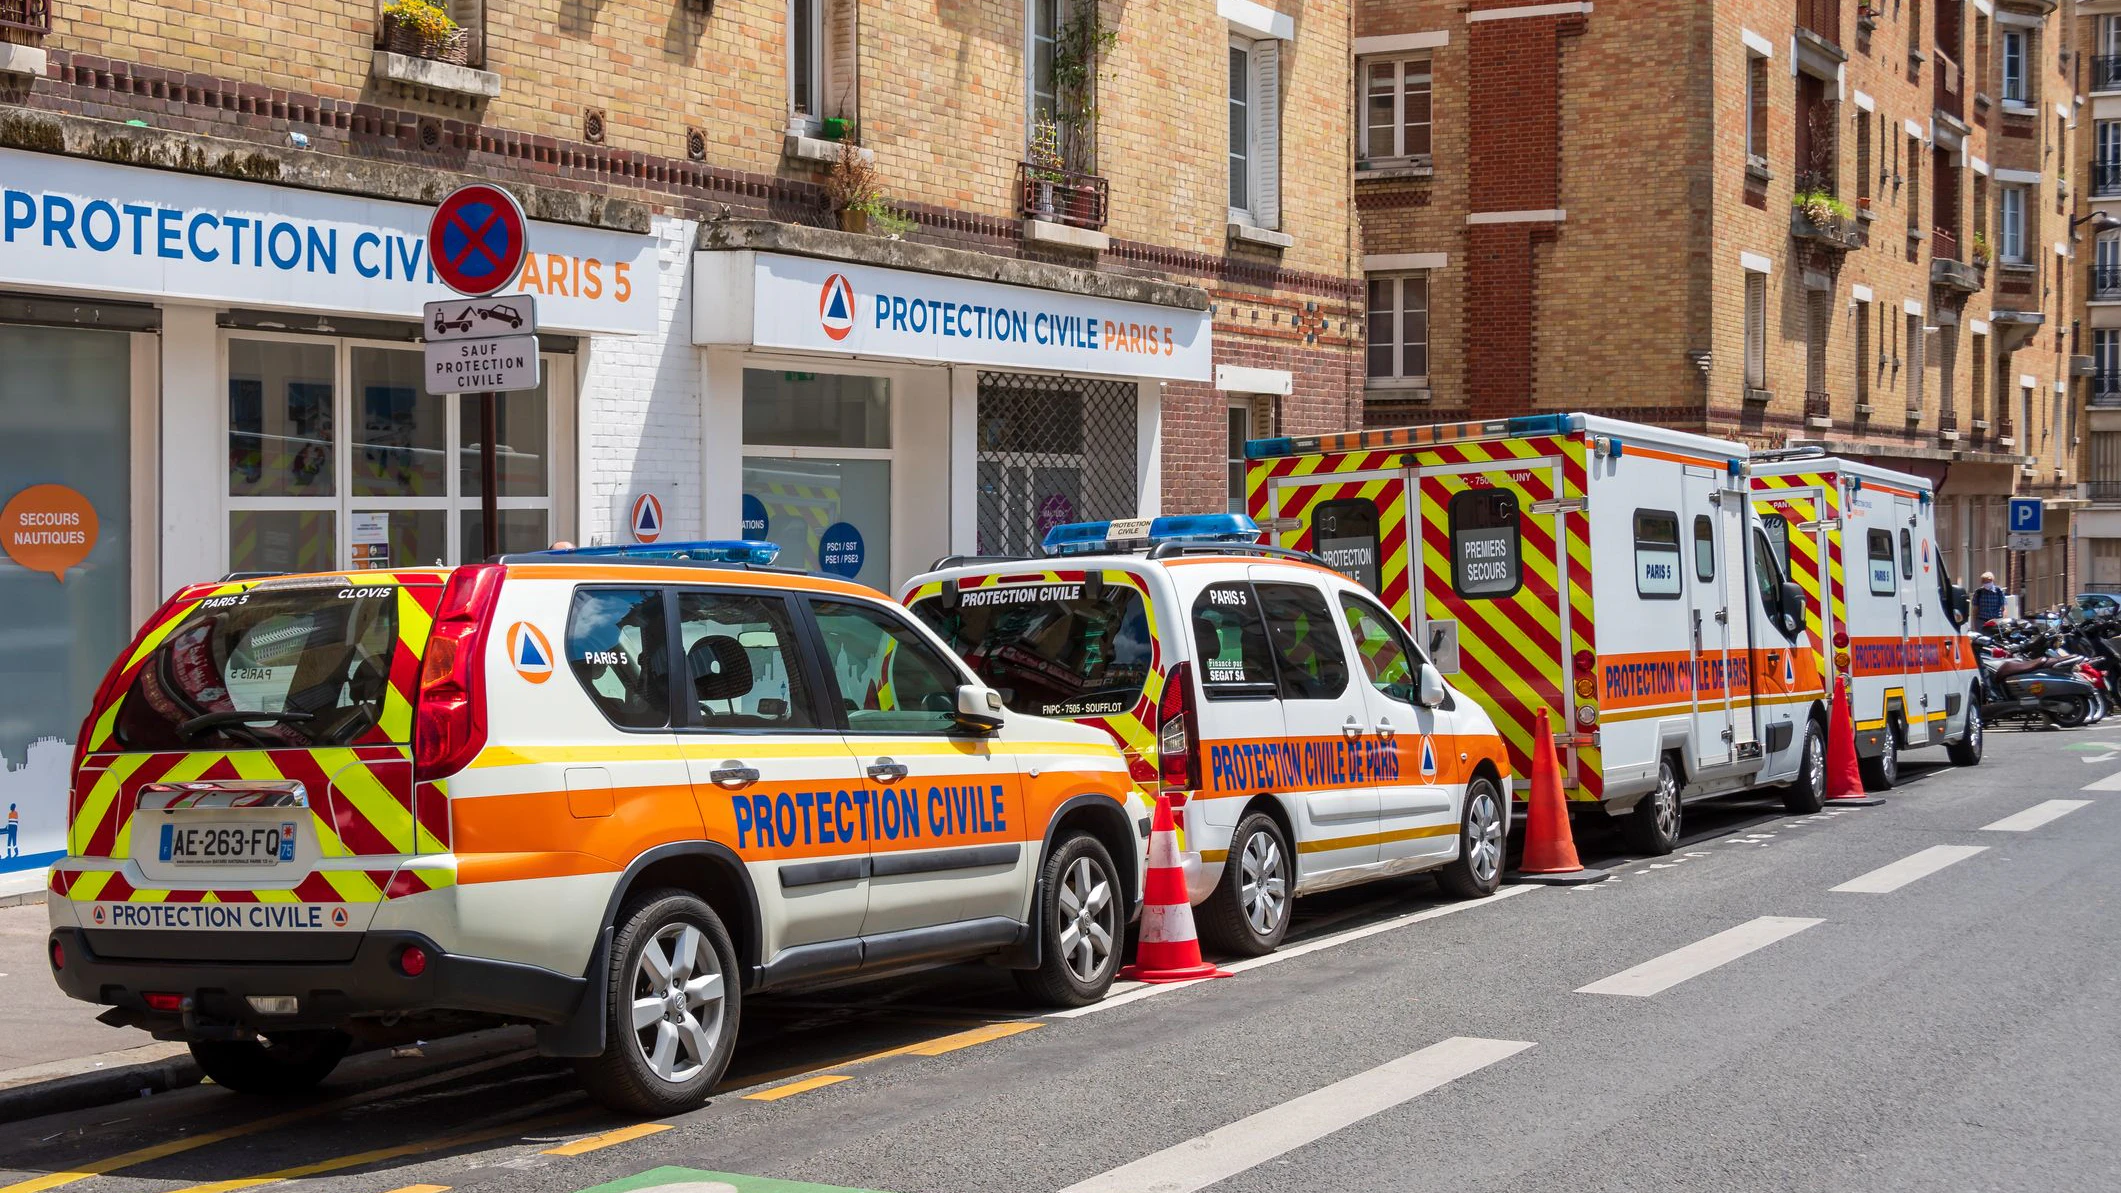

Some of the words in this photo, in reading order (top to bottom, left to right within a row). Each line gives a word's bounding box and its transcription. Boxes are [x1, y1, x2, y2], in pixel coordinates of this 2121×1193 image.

[4, 189, 337, 275] PROTECTION
[353, 232, 444, 285] CIVI
[517, 251, 602, 300] ARIS
[614, 261, 632, 303] 5
[875, 293, 1027, 343] PROTECTION
[1034, 312, 1098, 350] CIVILE
[1104, 320, 1158, 356] PARIS
[1164, 327, 1173, 356] 5
[461, 343, 498, 357] SAUF
[436, 356, 524, 375] PROTECTION
[457, 373, 504, 388] CIVILE
[19, 512, 80, 526] SECOURS
[2018, 505, 2033, 526] P
[1110, 520, 1151, 529] PROTECTION
[14, 531, 86, 545] NAUTIQUES
[826, 542, 841, 552] PSC1
[845, 541, 858, 551] SST
[1465, 538, 1507, 559] PREMIERS
[825, 555, 840, 564] PSE1
[843, 554, 859, 564] PSE2
[1323, 547, 1372, 567] PROTECTION
[1467, 560, 1507, 581] SECOURS
[1646, 564, 1665, 579] PARIS
[1666, 565, 1671, 579] 5
[1874, 569, 1885, 583] PARIS
[1886, 571, 1890, 583] 5
[337, 587, 392, 600] CLOVIS
[961, 588, 1038, 608] PROTECTION
[1039, 585, 1081, 601] CIVILE
[1209, 589, 1239, 605] PARIS
[1239, 590, 1247, 606] 5
[201, 595, 238, 609] PARIS
[238, 594, 250, 605] 5
[585, 651, 618, 665] PARIS
[621, 652, 628, 665] 5
[1208, 658, 1232, 667] Financé
[1233, 660, 1243, 669] par
[1210, 670, 1234, 681] SEGAT
[1235, 670, 1246, 681] SA
[1605, 661, 1675, 699] PROTECTION
[1711, 659, 1725, 690] DE
[1042, 704, 1061, 715] FNPC
[1065, 703, 1081, 714] 7505
[1085, 702, 1122, 713] SOUFFLOT
[1211, 741, 1303, 792] PROTECTION
[1304, 741, 1346, 787] CIVILE
[1347, 741, 1364, 783] DE
[1365, 739, 1399, 782] PARIS
[731, 787, 920, 849] PROTECTION
[927, 785, 1007, 838] CIVILE
[173, 828, 280, 857] AE-263-FQ
[281, 844, 293, 857] 75
[112, 905, 242, 927] PROTECTION
[249, 906, 323, 928] CIVILE
